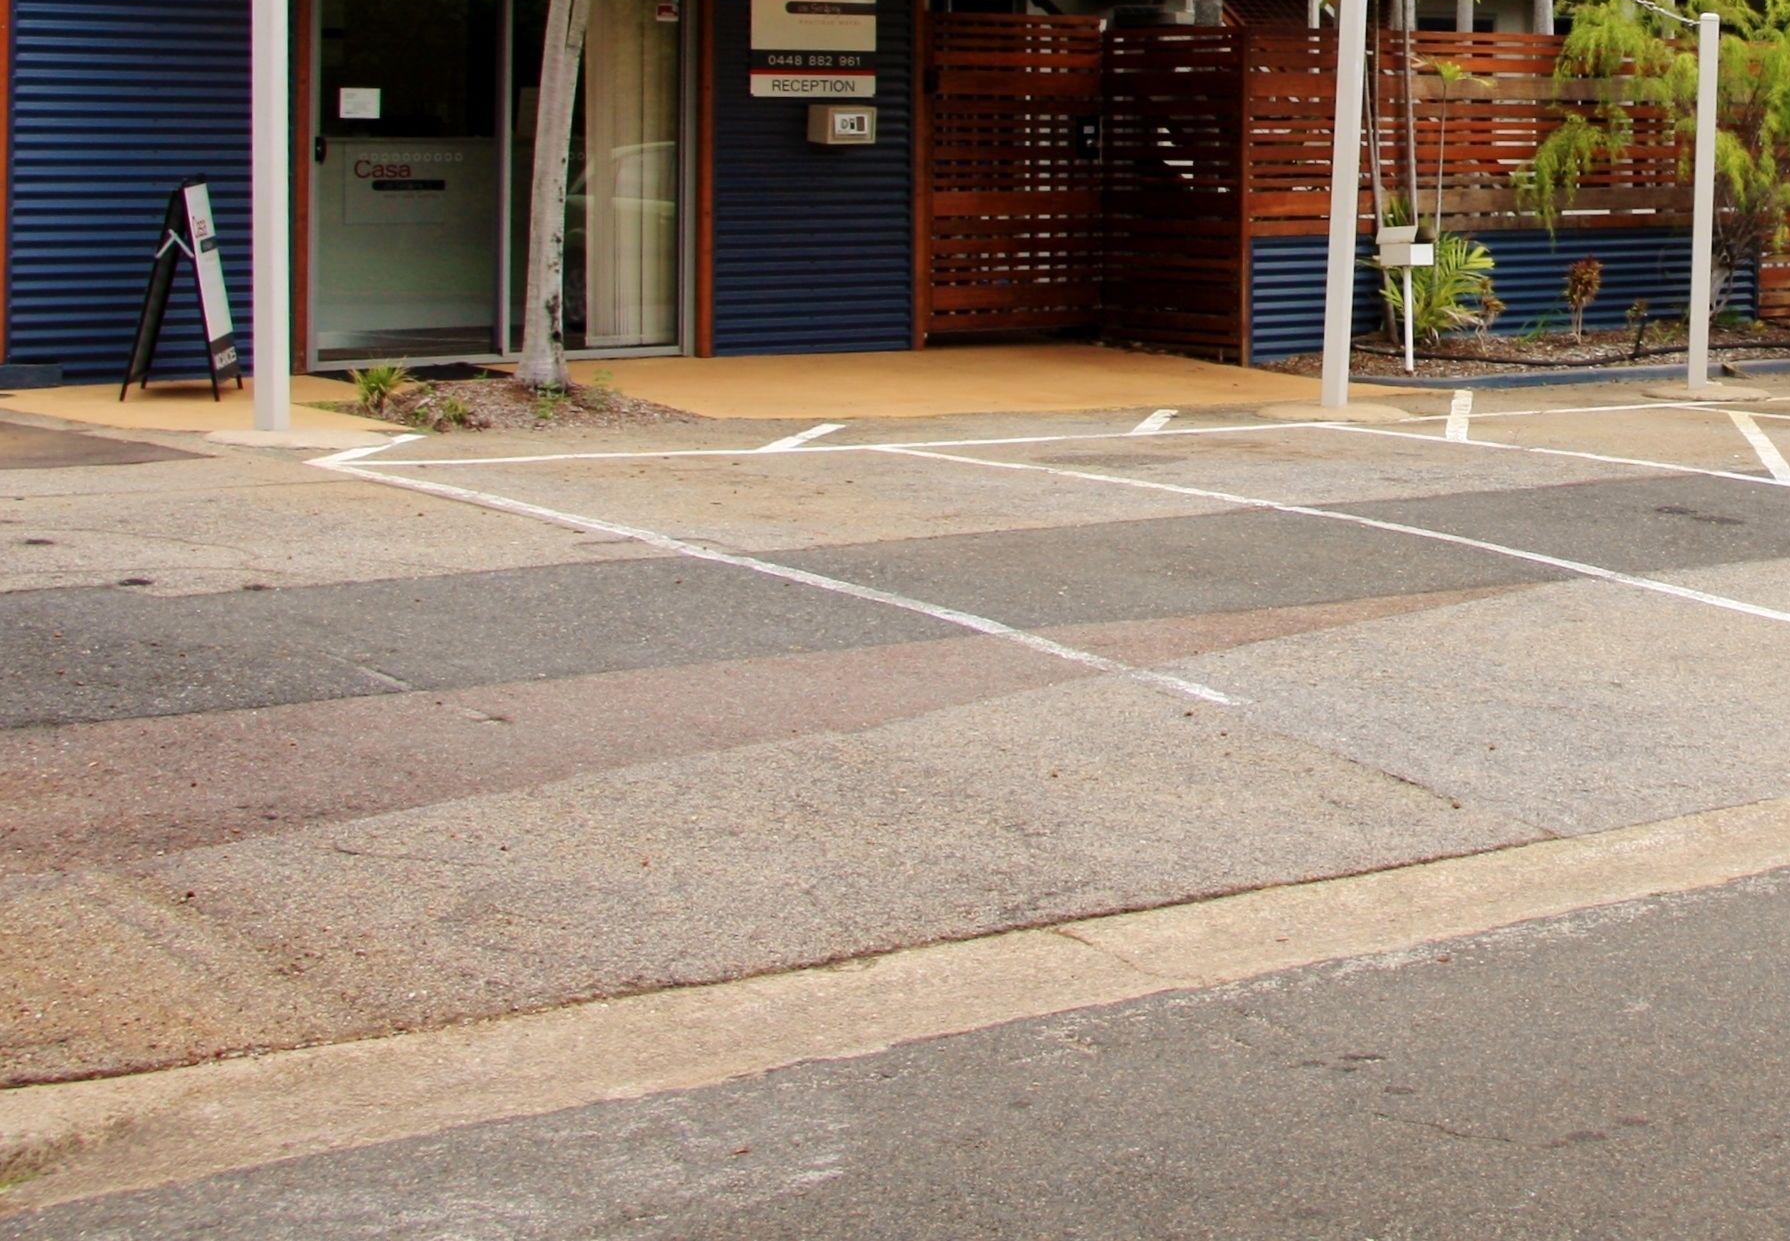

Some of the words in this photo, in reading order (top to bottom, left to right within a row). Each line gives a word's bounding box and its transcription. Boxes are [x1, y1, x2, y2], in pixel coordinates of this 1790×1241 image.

[768, 55, 803, 66] 0448
[808, 55, 833, 66] 882
[839, 56, 861, 67] 961
[771, 79, 856, 93] RECEPTION
[353, 160, 411, 179] Casa
